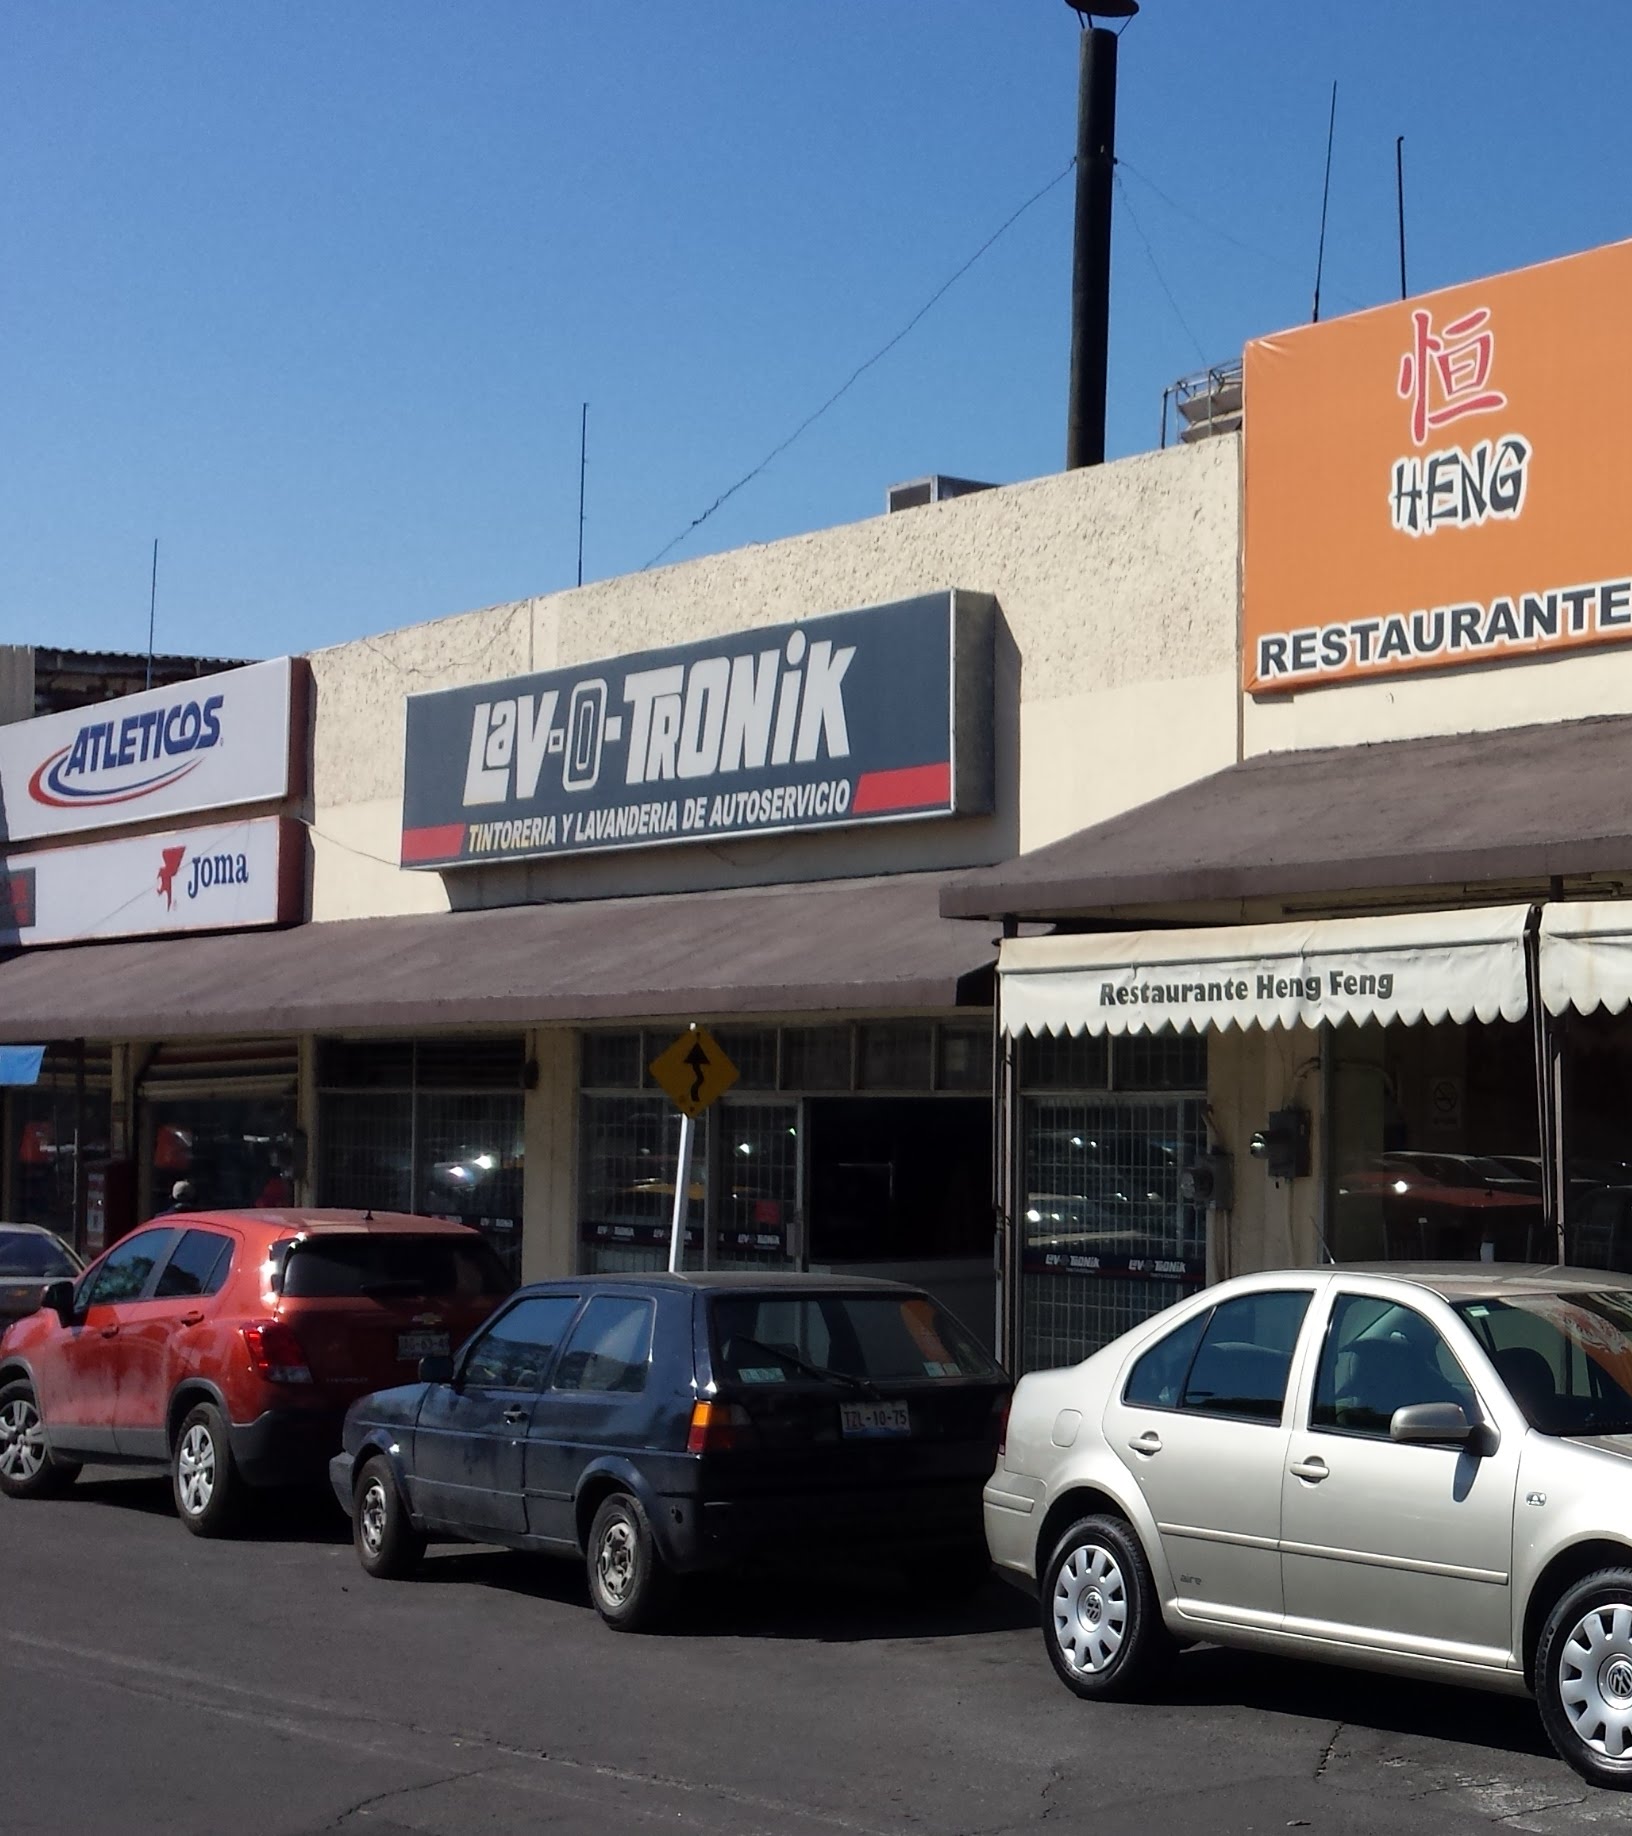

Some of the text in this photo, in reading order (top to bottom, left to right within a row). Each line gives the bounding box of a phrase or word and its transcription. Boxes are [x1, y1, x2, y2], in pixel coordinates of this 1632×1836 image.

[1397, 305, 1508, 446] 恒
[1392, 437, 1530, 538] HENG
[65, 694, 225, 777] ATLETICOS
[467, 778, 852, 854] TINTORERIA Y LAVANDERIA DE AUTOSERVICIO
[1099, 970, 1394, 1007] Restaurante Heng Feng
[843, 1409, 908, 1428] TZL-10-75
